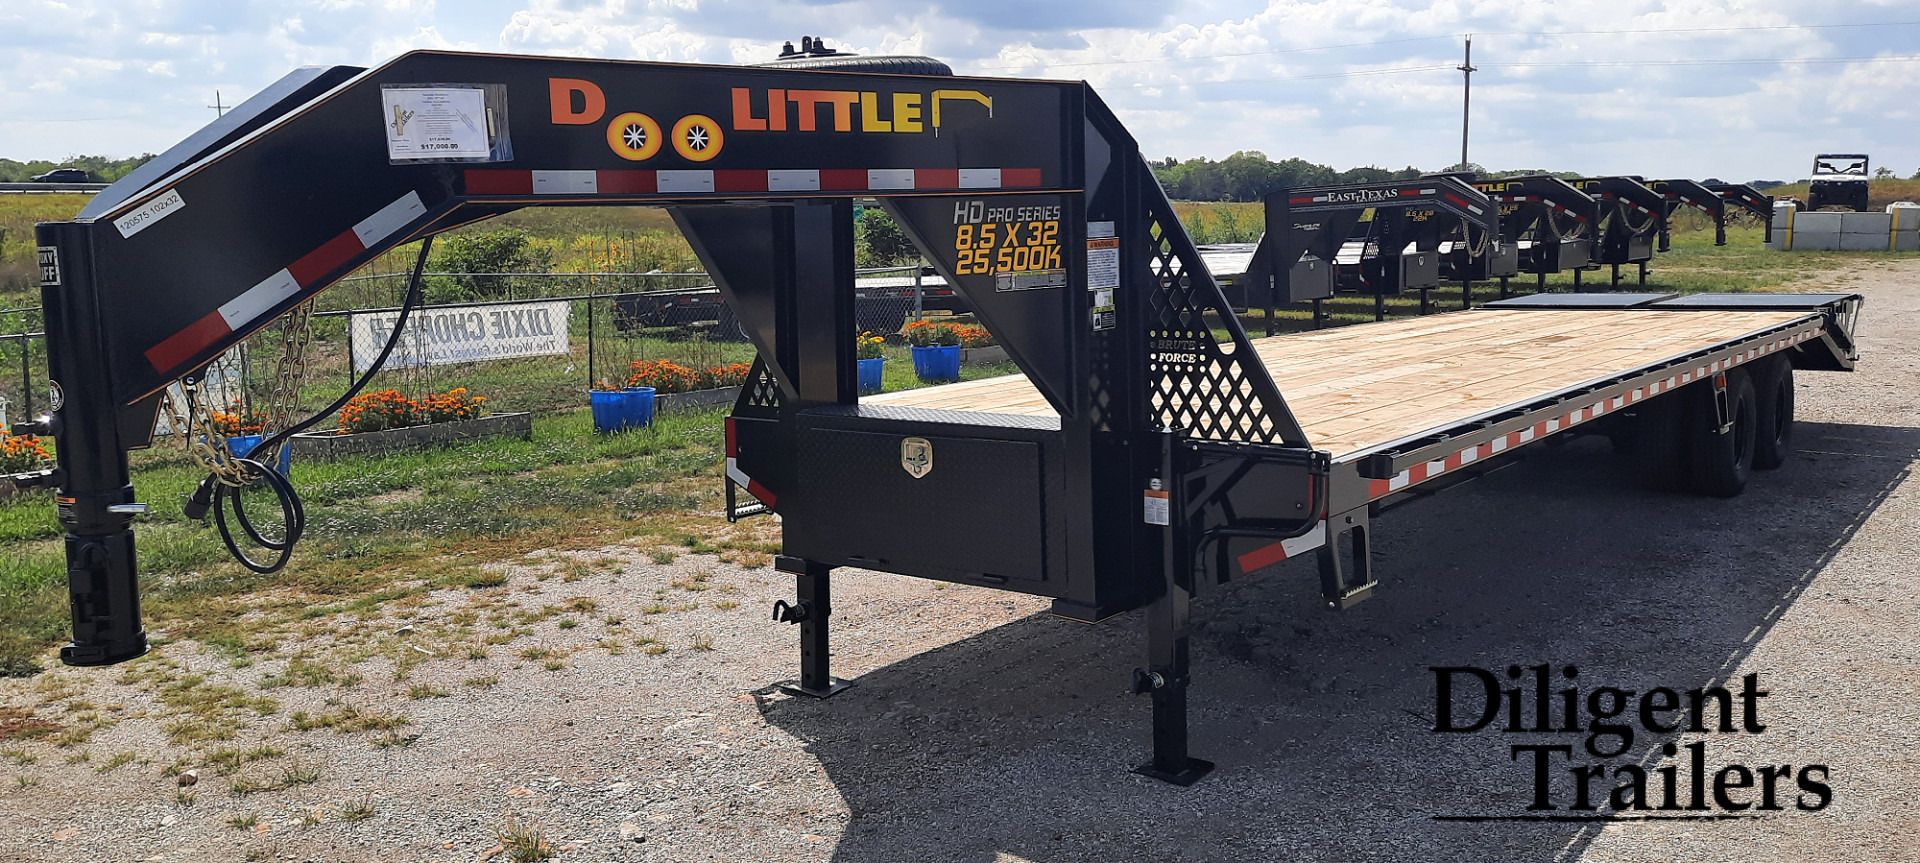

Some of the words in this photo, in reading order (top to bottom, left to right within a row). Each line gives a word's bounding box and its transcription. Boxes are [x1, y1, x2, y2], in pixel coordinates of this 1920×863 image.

[548, 77, 923, 162] DOOLITTLE
[1327, 192, 1358, 203] EAST
[1358, 188, 1398, 201] TEXAS
[120, 210, 150, 231] 120575
[149, 194, 179, 215] 102x32
[954, 200, 984, 225] HD
[987, 207, 1014, 223] PRO
[1017, 206, 1061, 222] SERIES
[956, 223, 997, 250] 8.5
[1002, 222, 1021, 248] X
[1027, 221, 1059, 246] 32
[956, 245, 1062, 276] 25,500K
[1157, 340, 1196, 350] BRUTE
[1158, 352, 1198, 363] FORCE
